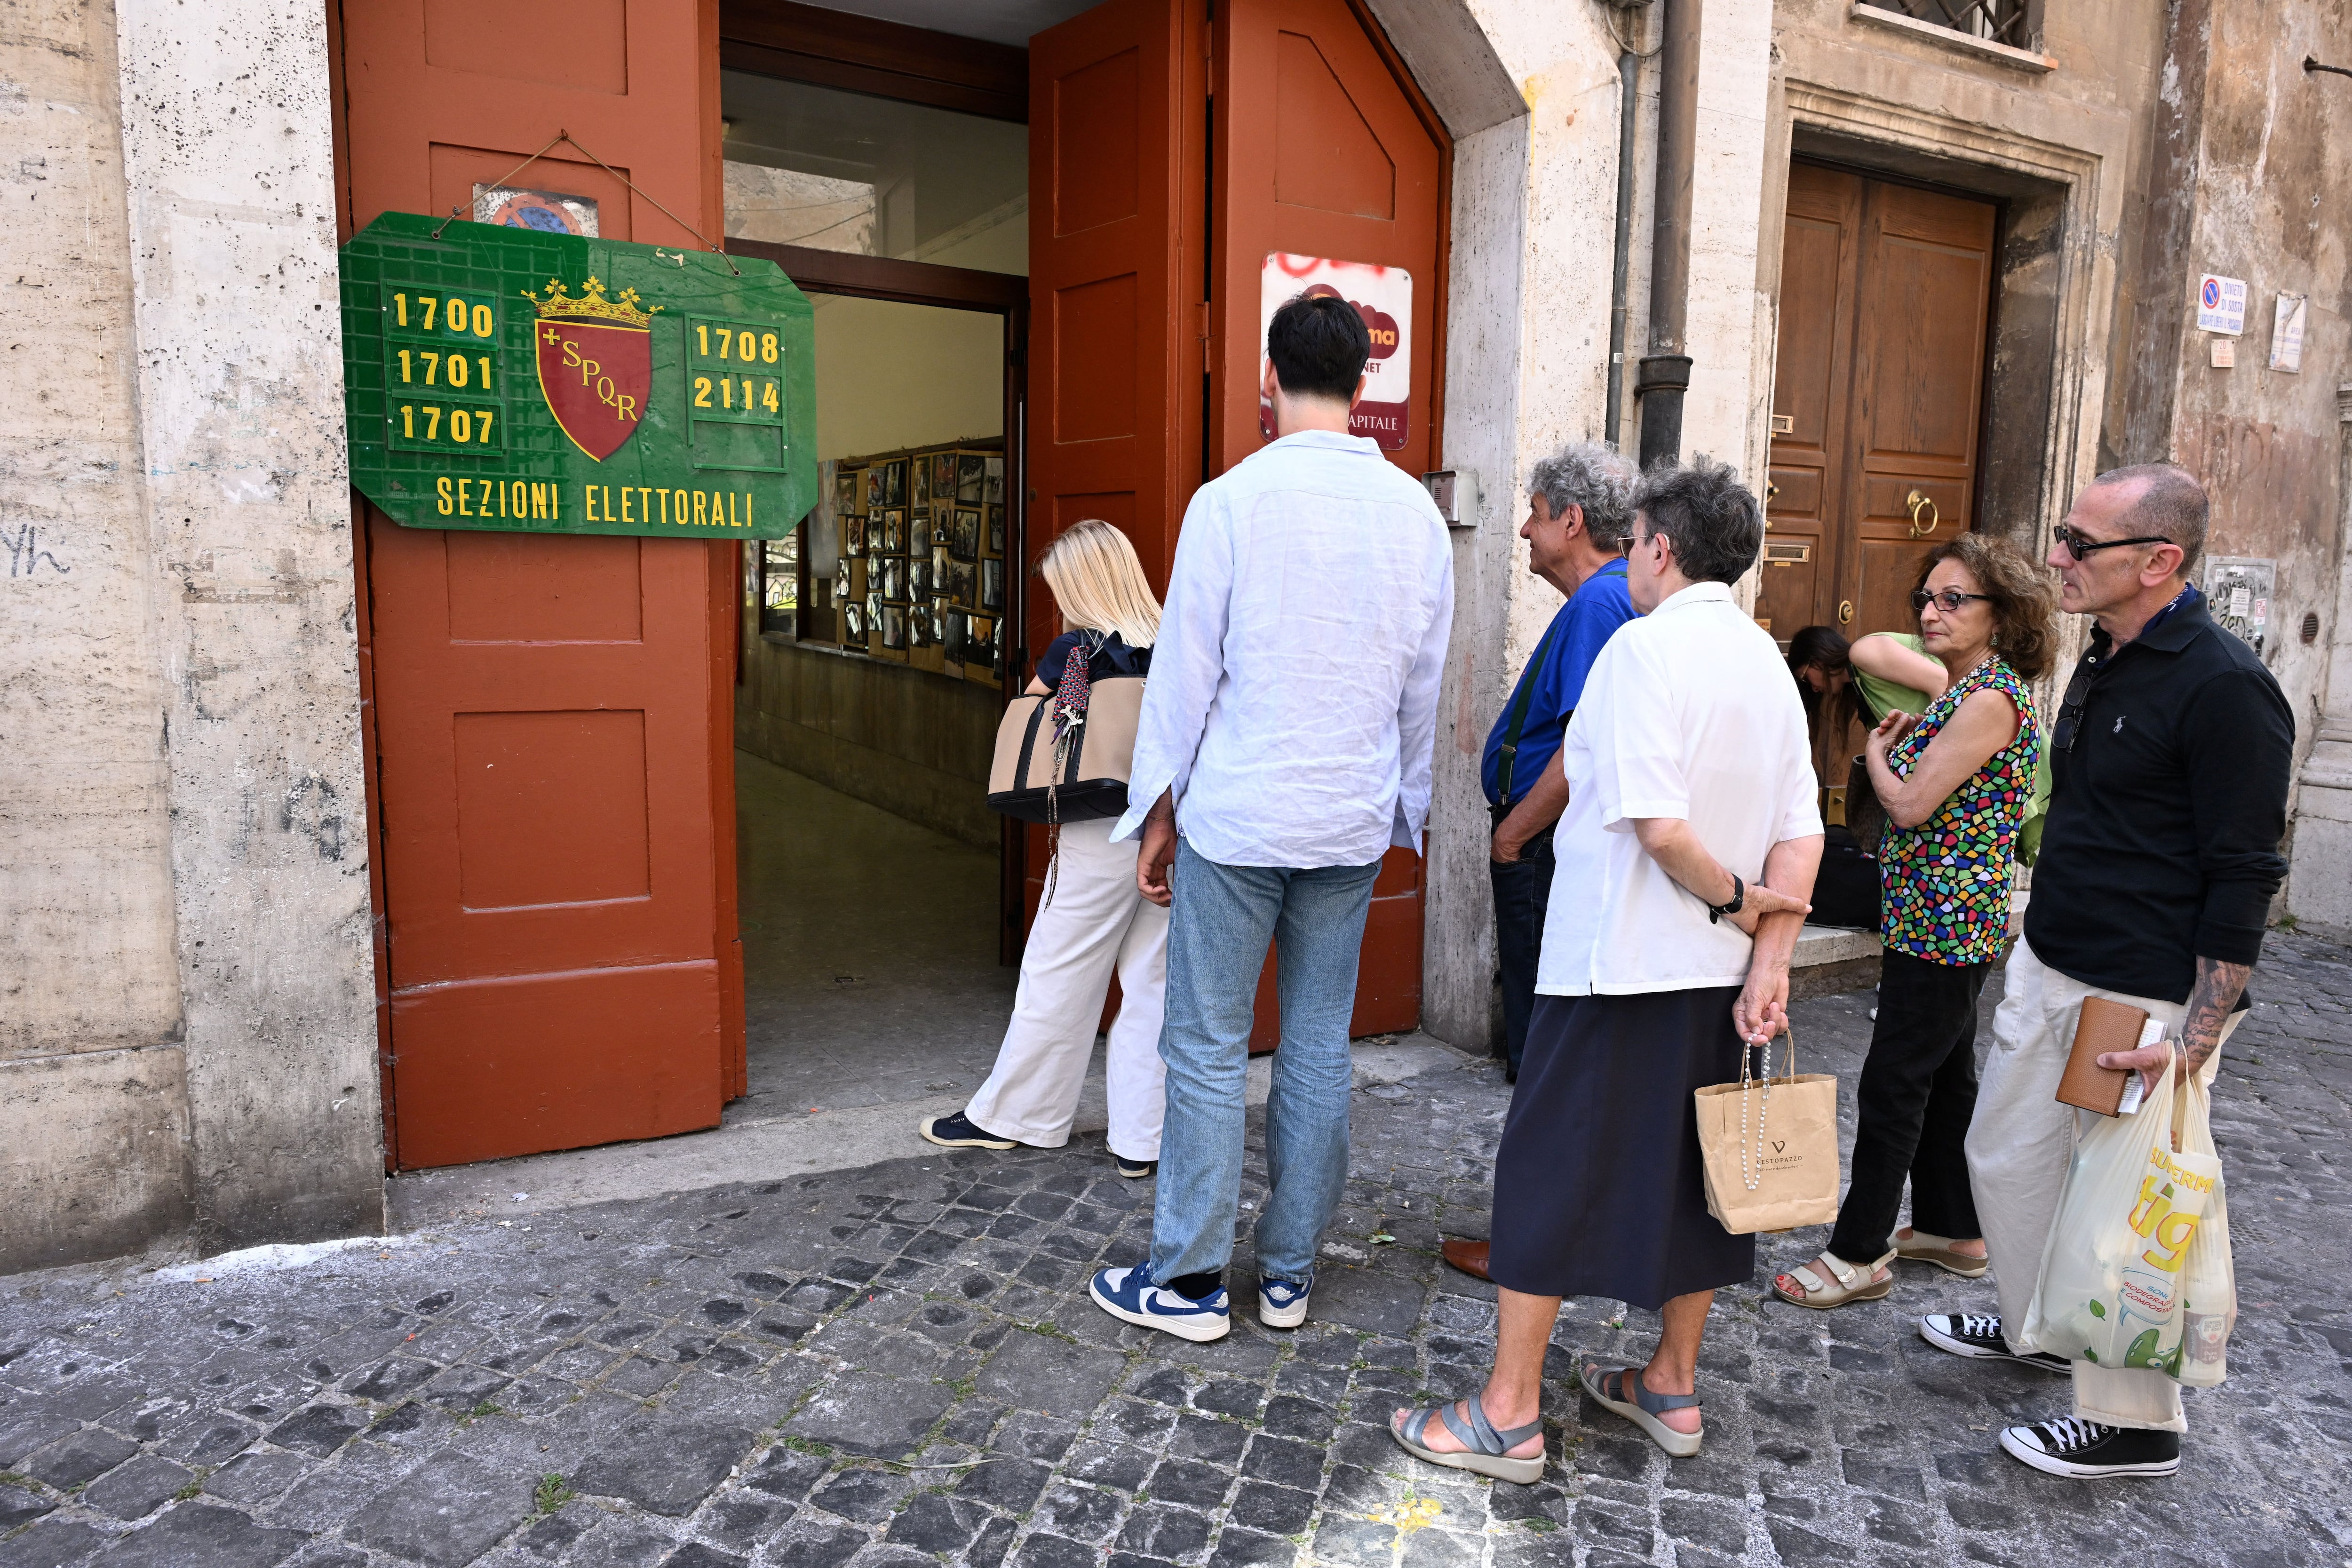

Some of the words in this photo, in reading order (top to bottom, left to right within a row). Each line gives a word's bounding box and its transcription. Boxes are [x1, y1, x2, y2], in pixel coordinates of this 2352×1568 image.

[2221, 299, 2226, 310] DI
[2228, 300, 2242, 313] SOSTA
[2225, 282, 2243, 297] DIVIETO
[394, 294, 493, 338] 1700
[697, 325, 779, 363] 1708
[2220, 341, 2226, 350] 20
[398, 350, 491, 389] 1701
[563, 341, 638, 421] SPQR
[694, 377, 779, 413] 2114
[401, 405, 493, 443] 1707
[1348, 414, 1398, 430] APITALE
[437, 477, 559, 520] SEZIONI
[586, 485, 753, 527] ELETTORALI
[2128, 1175, 2201, 1273] tig
